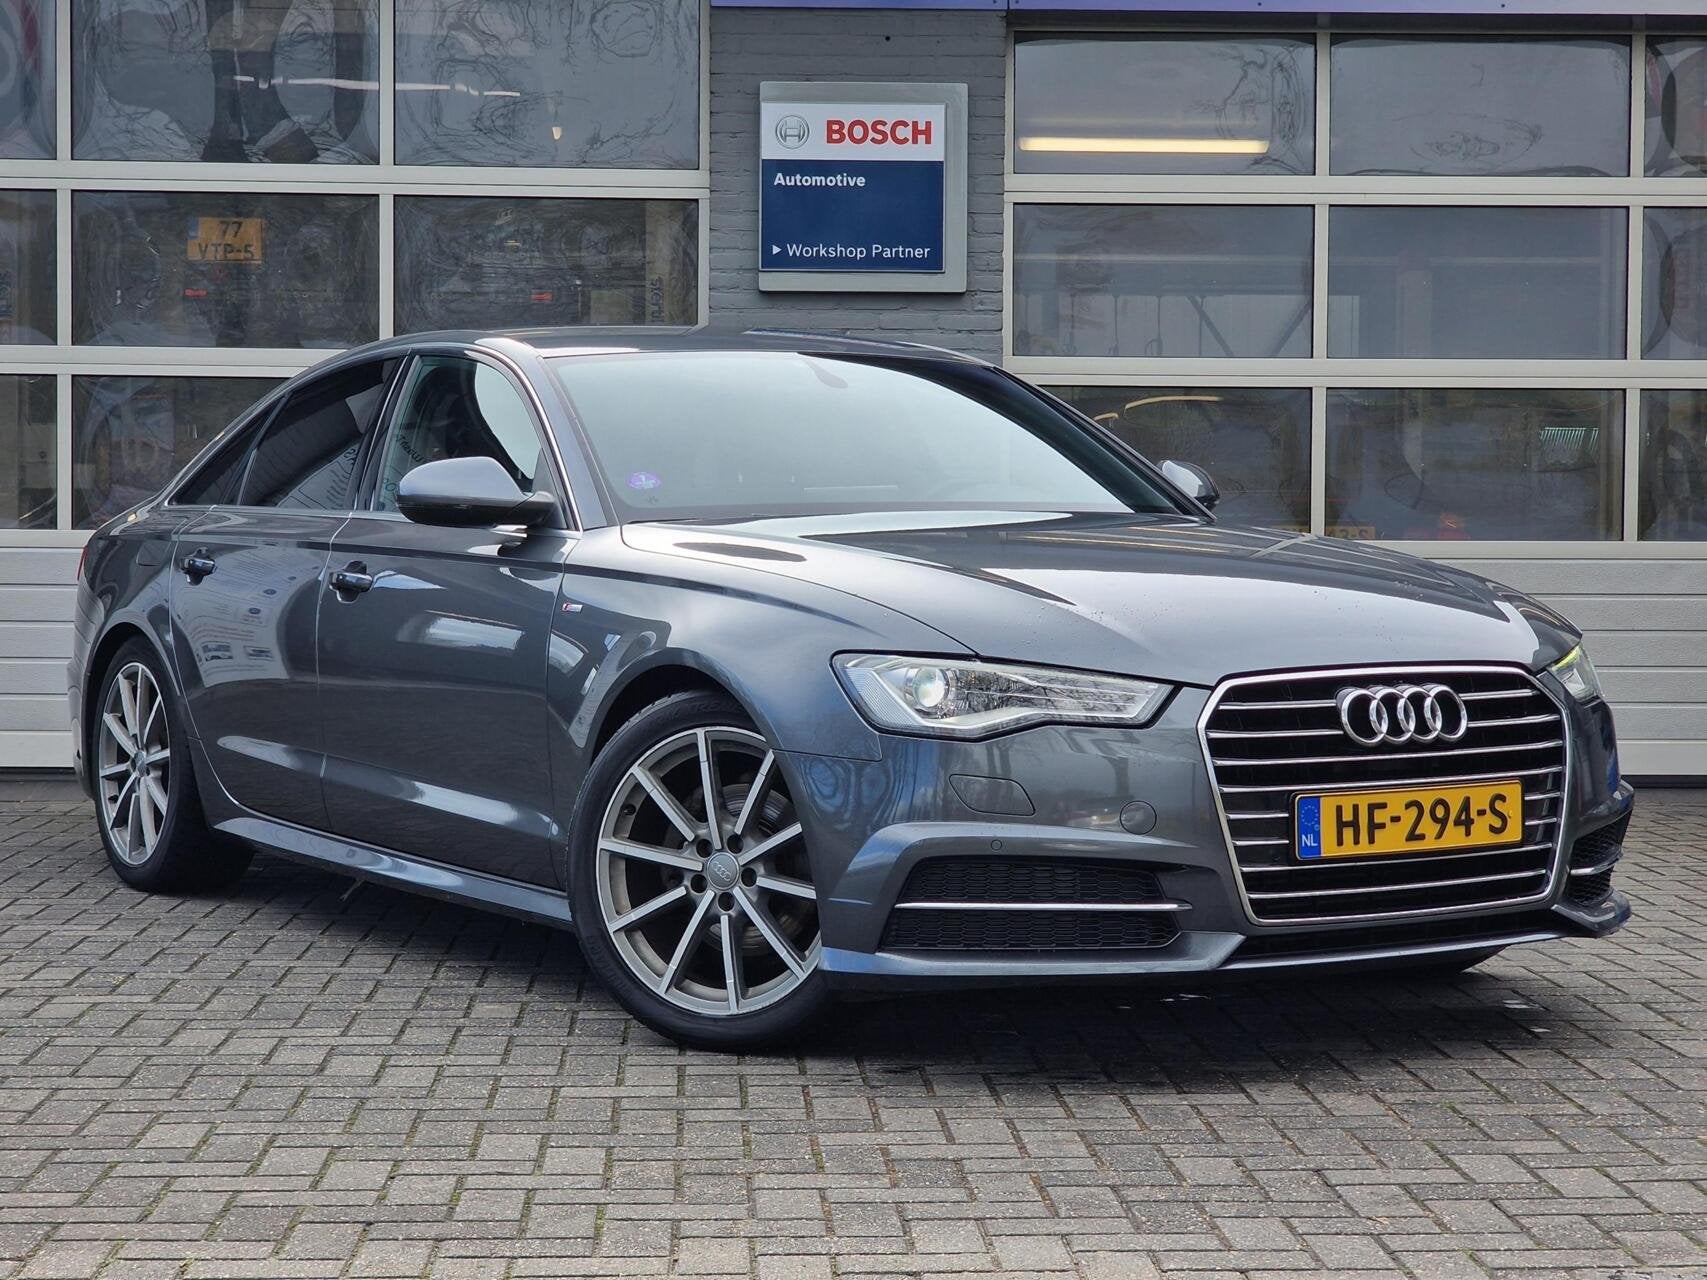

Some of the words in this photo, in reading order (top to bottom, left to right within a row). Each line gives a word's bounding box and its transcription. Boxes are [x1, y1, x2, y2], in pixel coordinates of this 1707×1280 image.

[826, 119, 932, 145] BOSCH
[774, 172, 866, 187] Automotive
[219, 221, 243, 238] 77
[198, 243, 255, 259] VTP-5
[787, 244, 867, 260] Workshop
[872, 245, 930, 258] Partner
[1335, 793, 1508, 847] HF-294-S
[1301, 834, 1318, 847] NL
